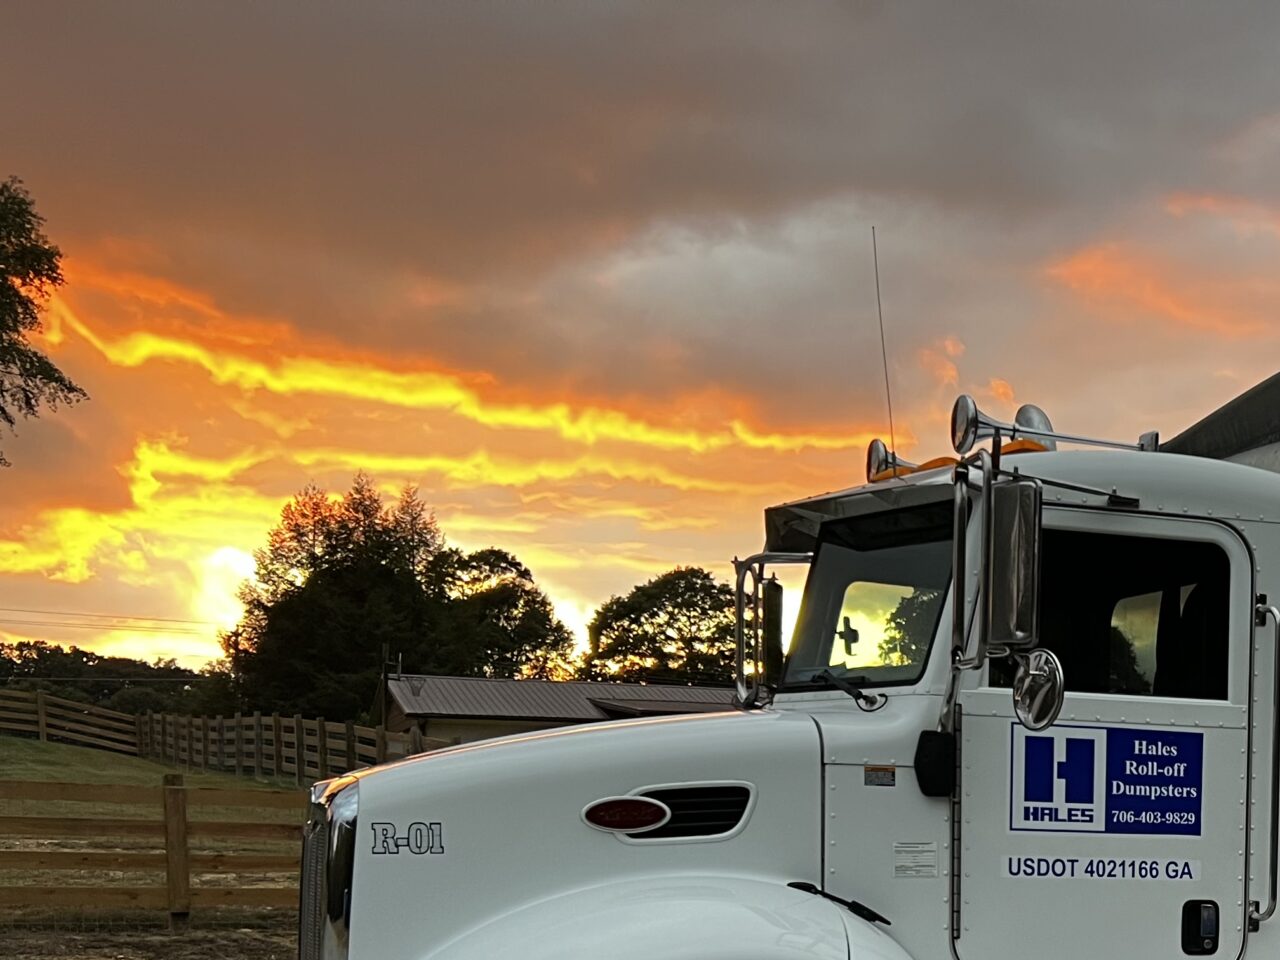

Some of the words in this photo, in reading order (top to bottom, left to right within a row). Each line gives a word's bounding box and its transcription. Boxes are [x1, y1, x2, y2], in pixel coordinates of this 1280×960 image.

[1133, 739, 1178, 757] Hales
[1125, 760, 1187, 777] Roll-off
[1111, 780, 1198, 800] Dumpsters
[1023, 806, 1094, 823] HALES
[1111, 810, 1196, 825] 706-403-9829
[371, 822, 445, 855] R-01
[1008, 857, 1079, 877] USDOT
[1084, 859, 1159, 879] 4021166
[1165, 861, 1193, 880] GA
